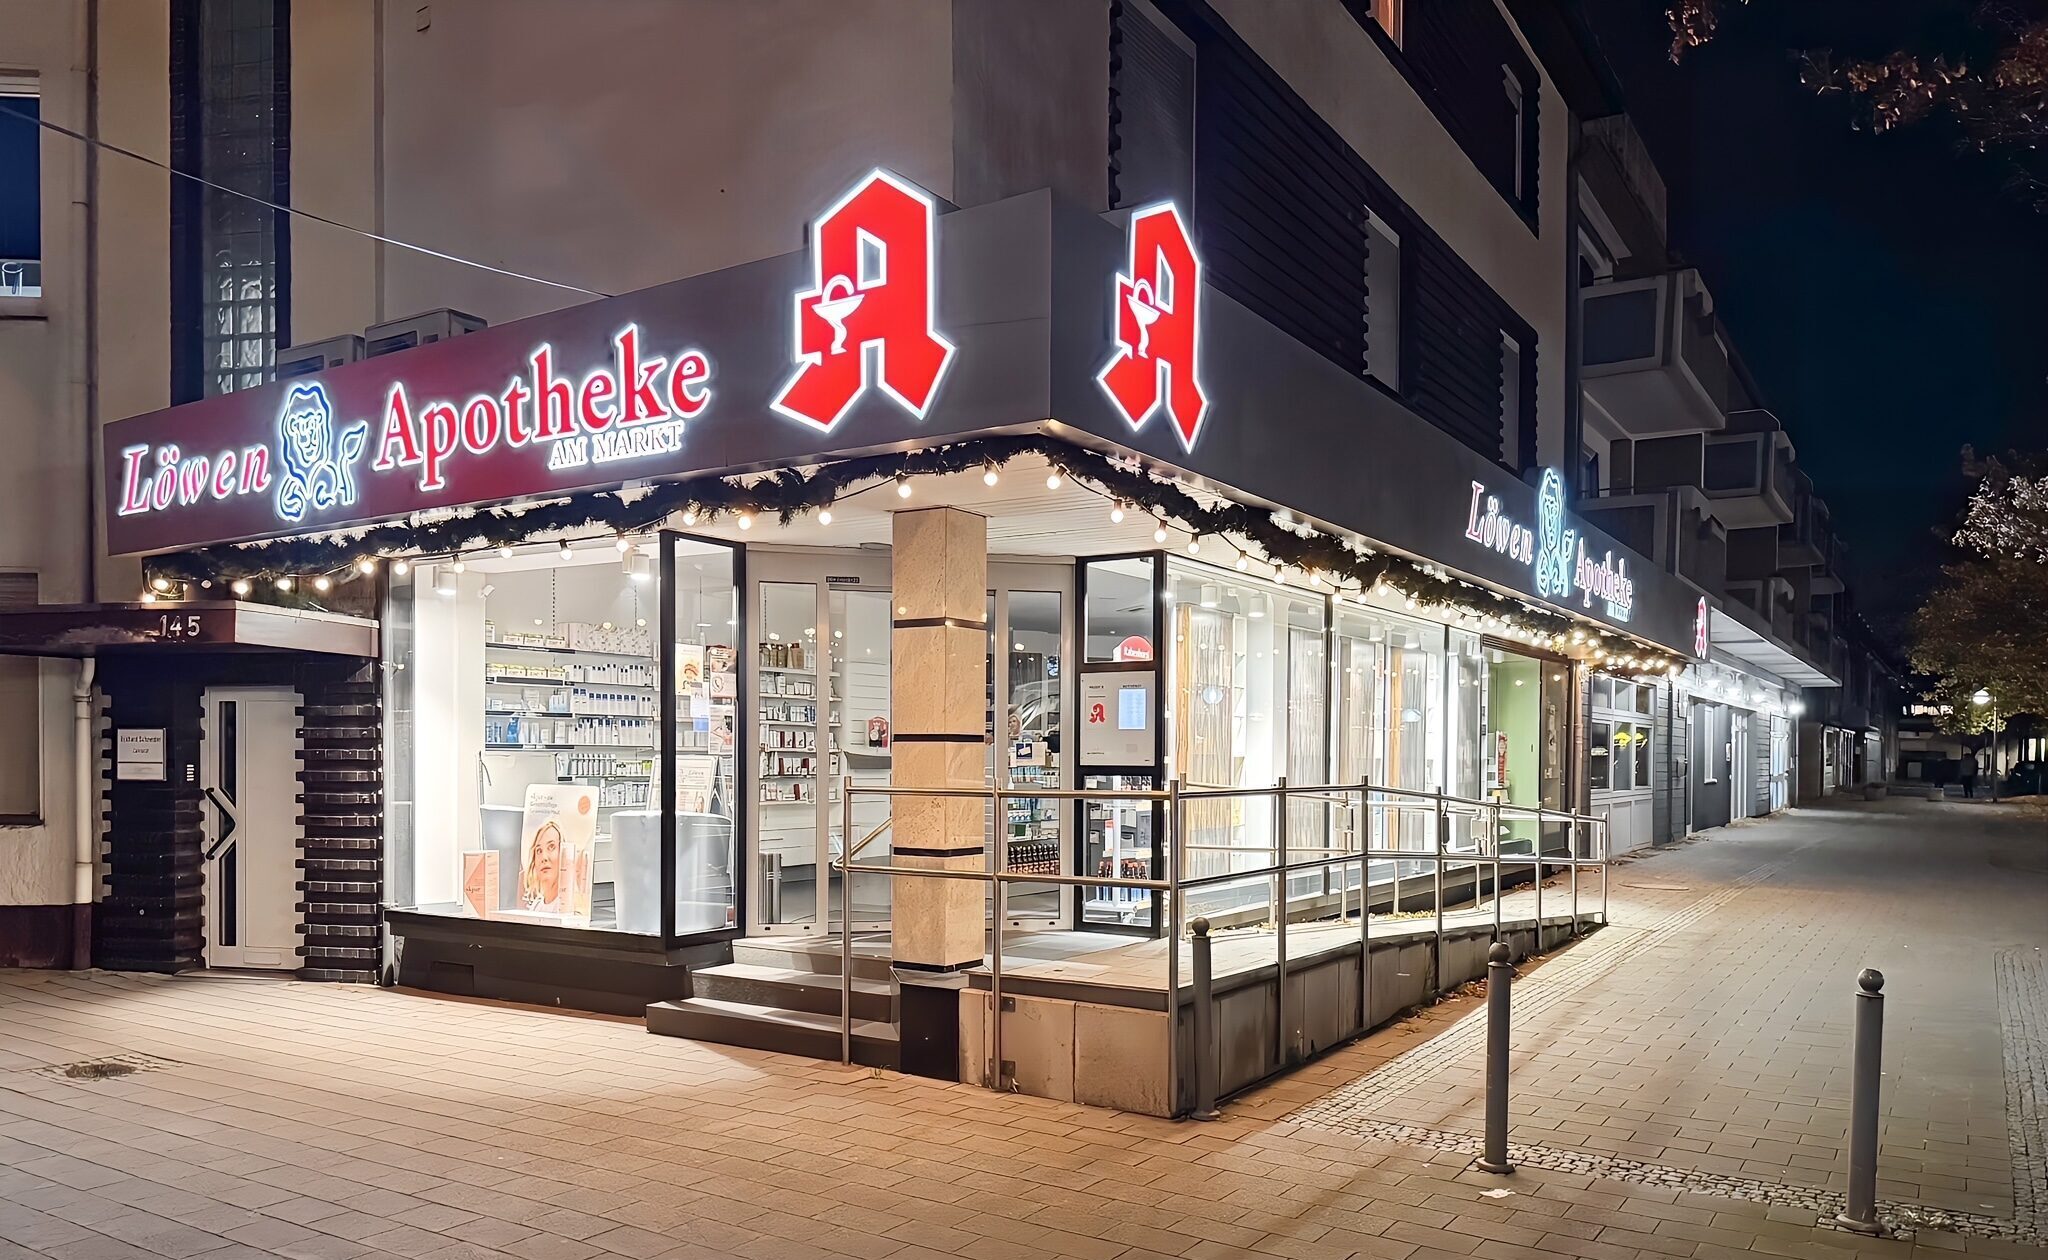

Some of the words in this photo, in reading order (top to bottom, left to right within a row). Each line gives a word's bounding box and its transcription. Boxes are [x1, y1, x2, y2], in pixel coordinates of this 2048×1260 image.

[770, 168, 956, 433] A
[1097, 202, 1208, 454] A
[118, 444, 271, 516] Löwen
[373, 323, 712, 492] Apotheke
[549, 436, 588, 470] AM
[591, 420, 685, 463] MARKT
[1466, 480, 1533, 566] Löwen
[1573, 536, 1633, 609] Apotheke
[160, 615, 201, 637] 145
